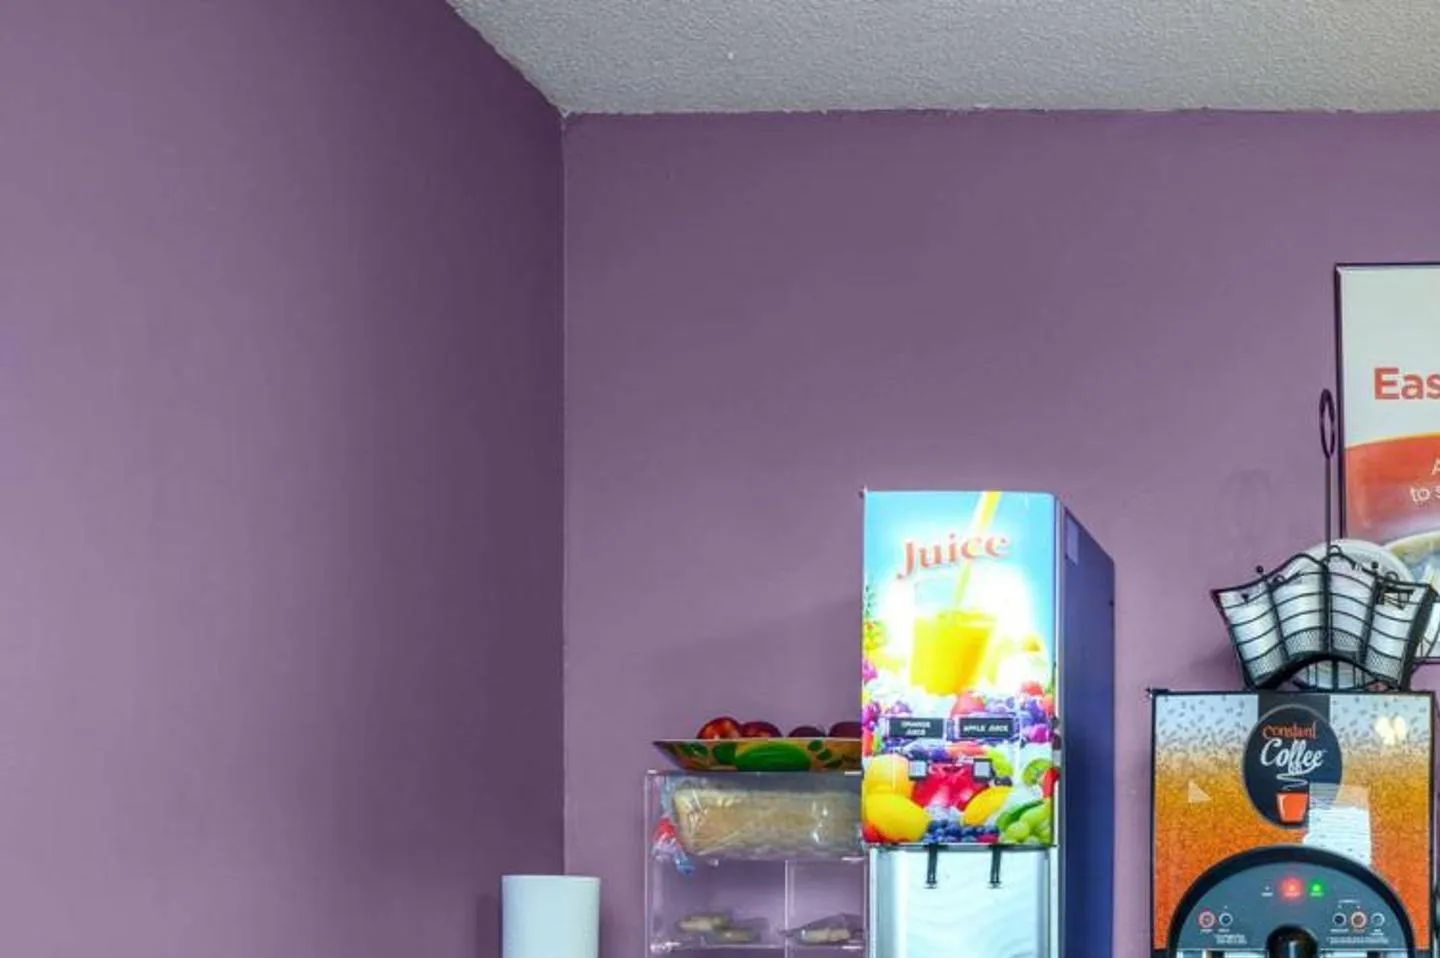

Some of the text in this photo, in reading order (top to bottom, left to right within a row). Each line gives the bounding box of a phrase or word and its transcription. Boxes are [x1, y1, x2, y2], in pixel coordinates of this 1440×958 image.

[1410, 486, 1430, 502] to
[897, 533, 1008, 579] Juice
[1260, 737, 1327, 776] Coffee
